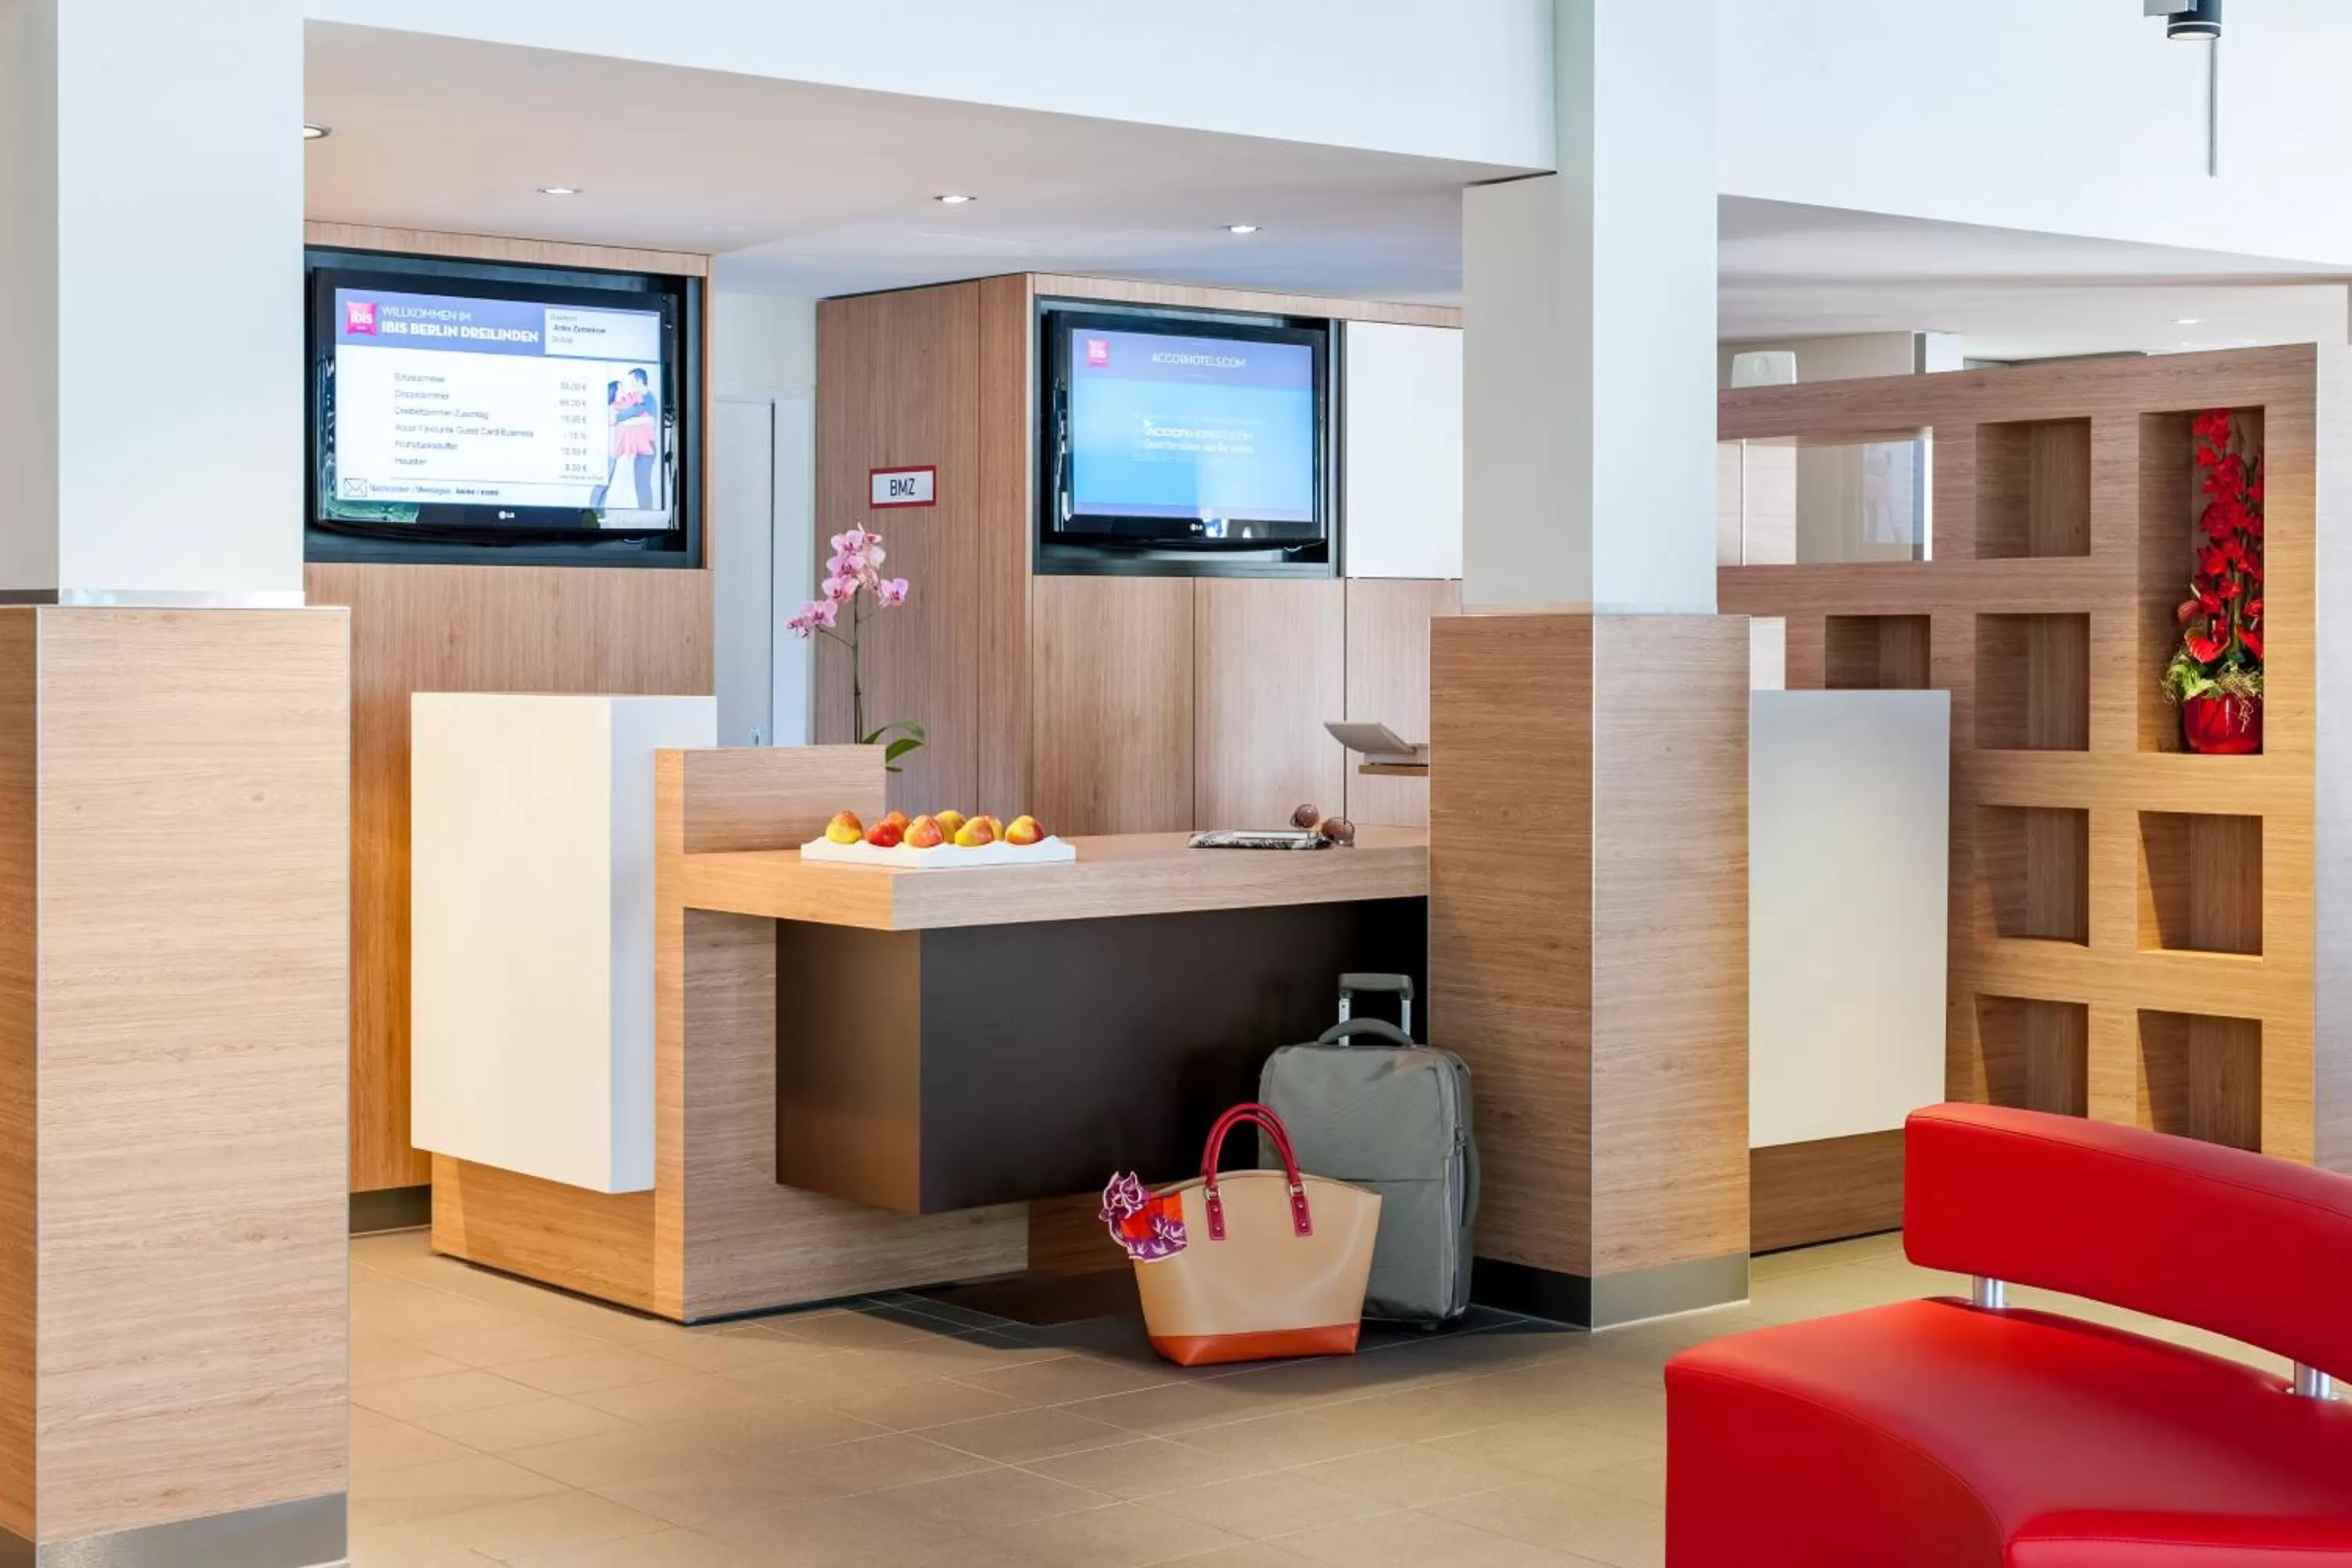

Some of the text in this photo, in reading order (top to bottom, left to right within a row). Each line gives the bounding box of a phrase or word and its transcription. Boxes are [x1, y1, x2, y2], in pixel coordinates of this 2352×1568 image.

[350, 309, 373, 324] ibis
[382, 306, 458, 321] WILLKOMMEN
[382, 321, 407, 334] IBIS
[410, 323, 458, 338] BERLIN
[460, 325, 539, 343] DREILINDEN
[1150, 352, 1246, 368] ACCORHOTELS.COM
[890, 477, 916, 496] BMZ
